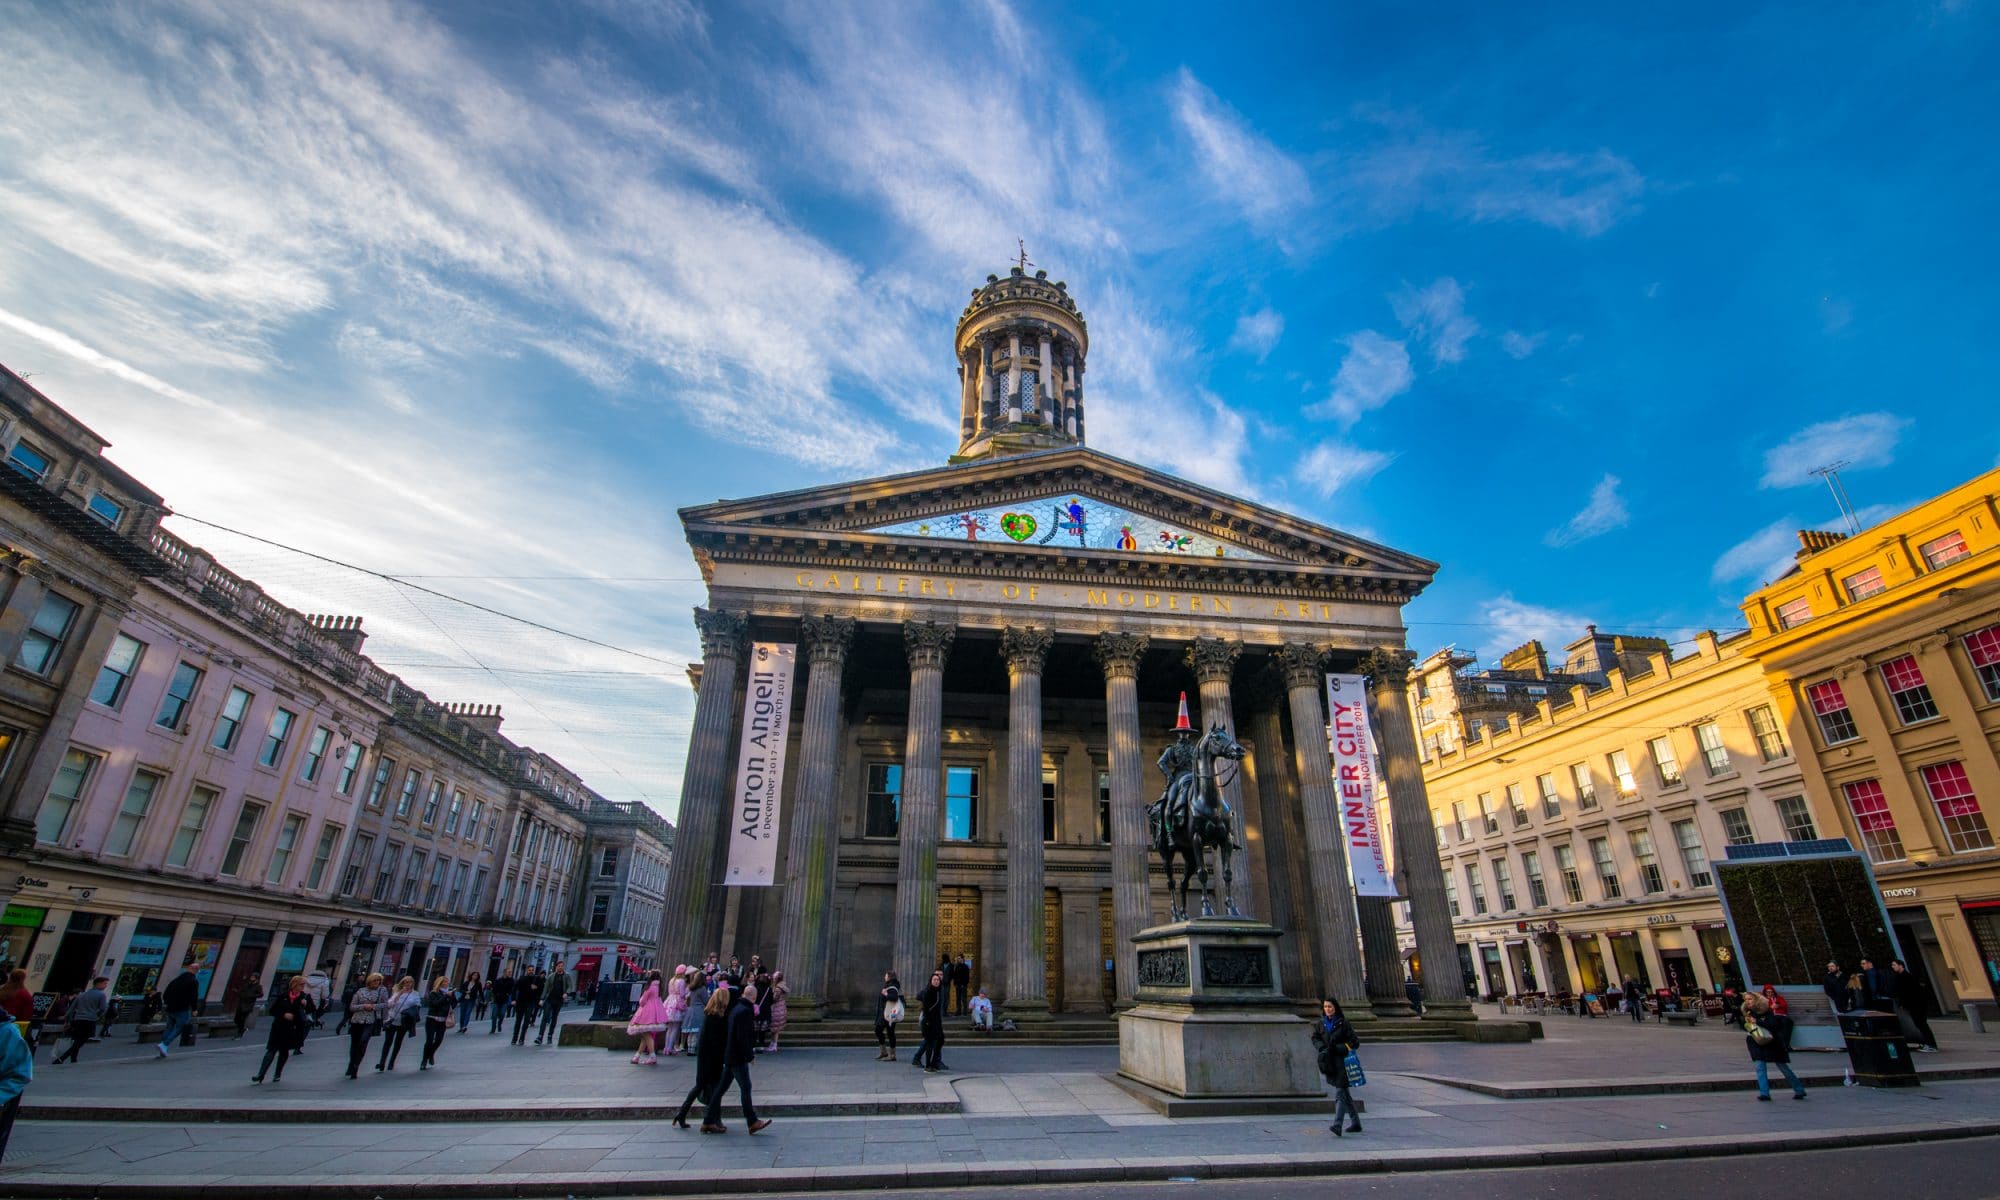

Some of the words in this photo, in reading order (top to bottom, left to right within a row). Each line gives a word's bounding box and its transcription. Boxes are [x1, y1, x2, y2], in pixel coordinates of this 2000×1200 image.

[796, 572, 957, 598] GALLERY
[1002, 583, 1040, 603] OF
[1087, 589, 1231, 614] MODERN
[1272, 601, 1331, 621] ART
[777, 672, 786, 697] 2018
[750, 671, 775, 750] Angell
[773, 699, 784, 730] March
[1333, 701, 1357, 757] CITY
[1352, 700, 1363, 722] 2018
[1355, 725, 1371, 780] NOVEMBER
[741, 757, 765, 841] Aaron
[763, 777, 776, 831] December
[1341, 764, 1370, 848] INNER
[763, 832, 770, 840] 8
[1366, 805, 1383, 862] FEBRUARY
[1376, 862, 1385, 874] 15
[1883, 887, 1917, 898] money
